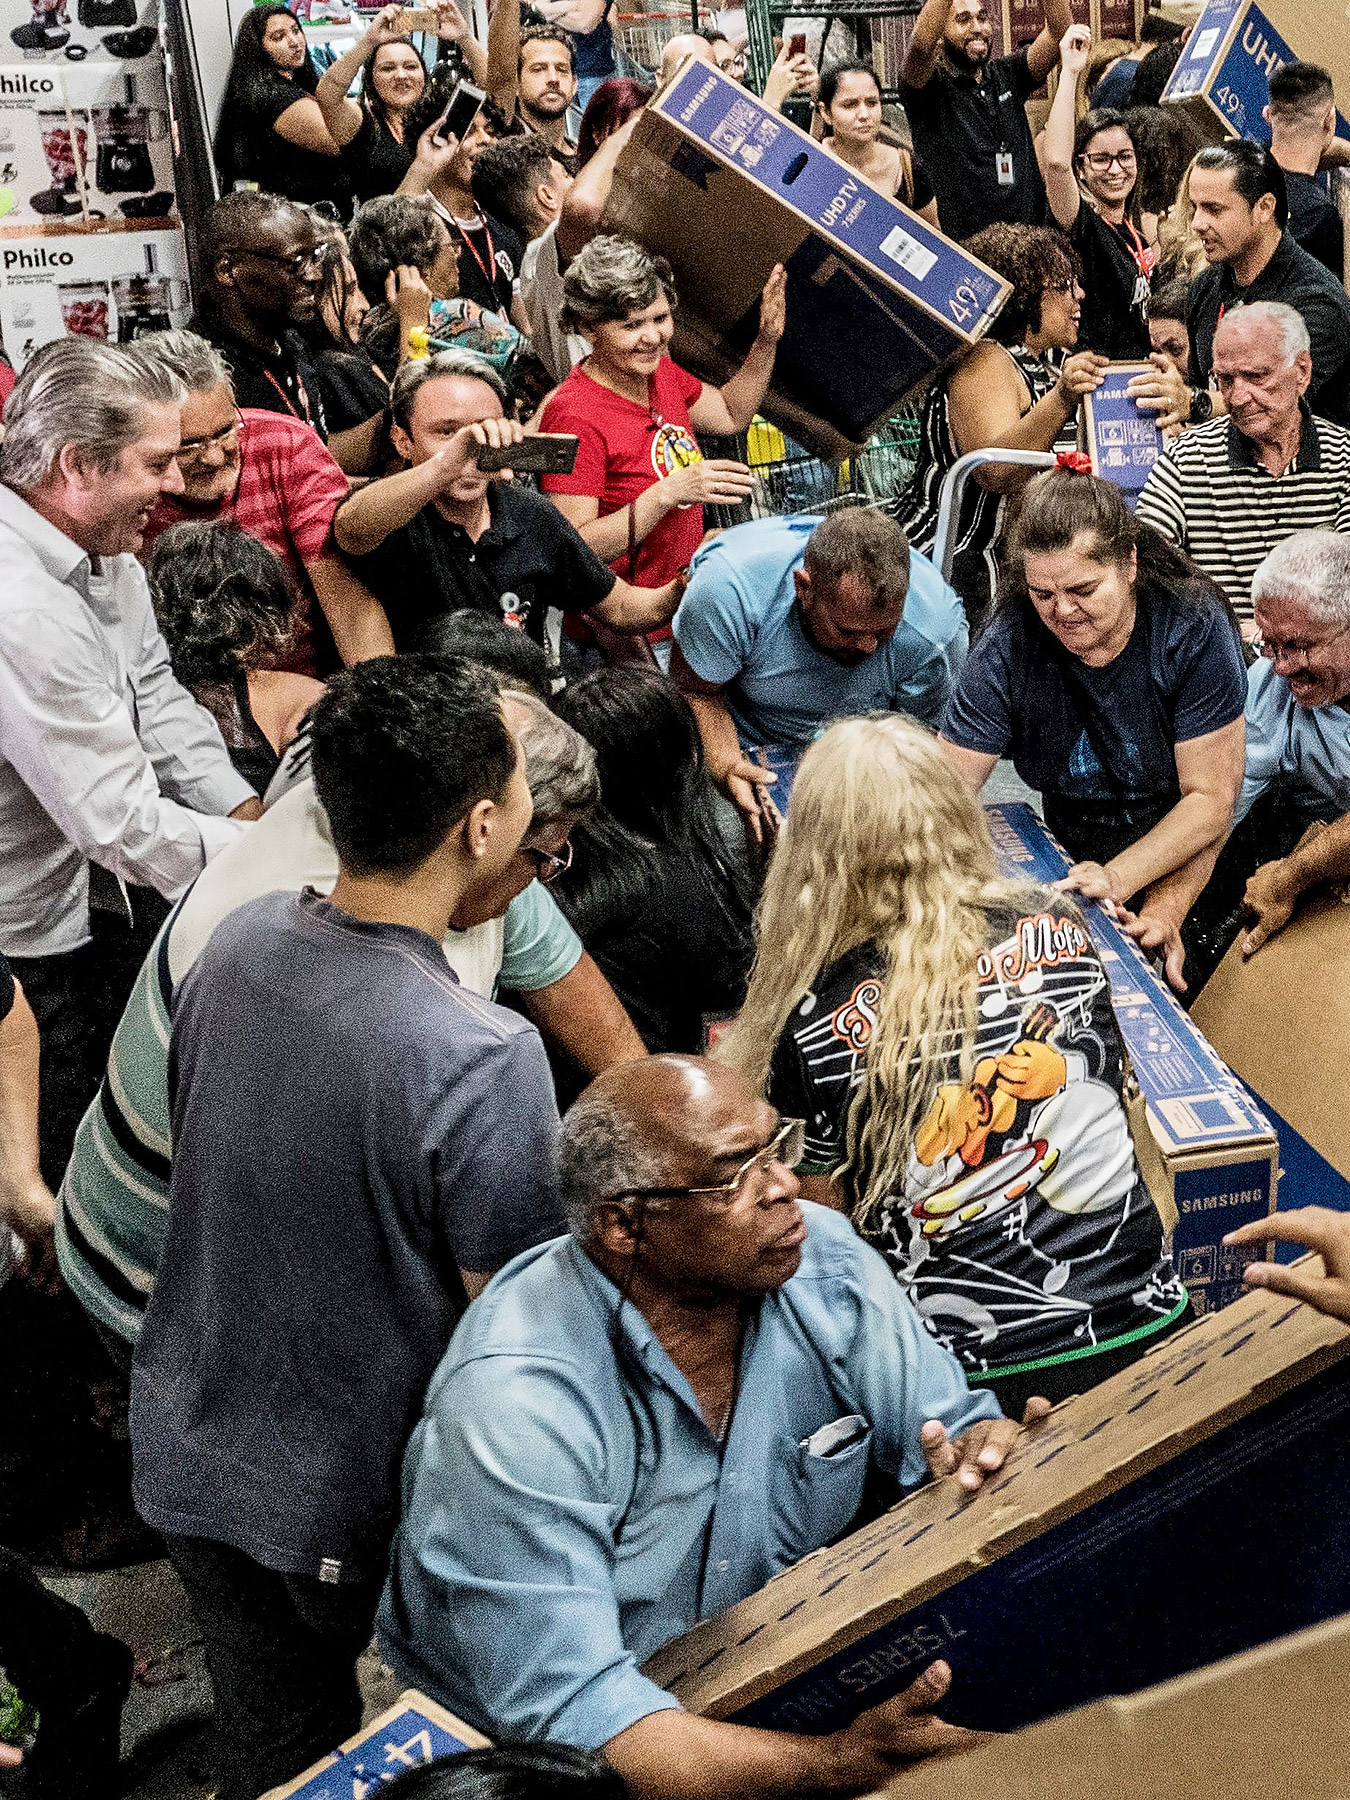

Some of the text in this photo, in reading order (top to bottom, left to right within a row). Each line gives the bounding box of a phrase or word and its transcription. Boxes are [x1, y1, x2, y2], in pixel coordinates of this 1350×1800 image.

[1242, 22, 1285, 77] UH
[1, 74, 54, 93] hilco
[4, 248, 74, 269] Philco
[1181, 1188, 1262, 1213] SAMSUNG
[837, 1624, 946, 1693] SERIES
